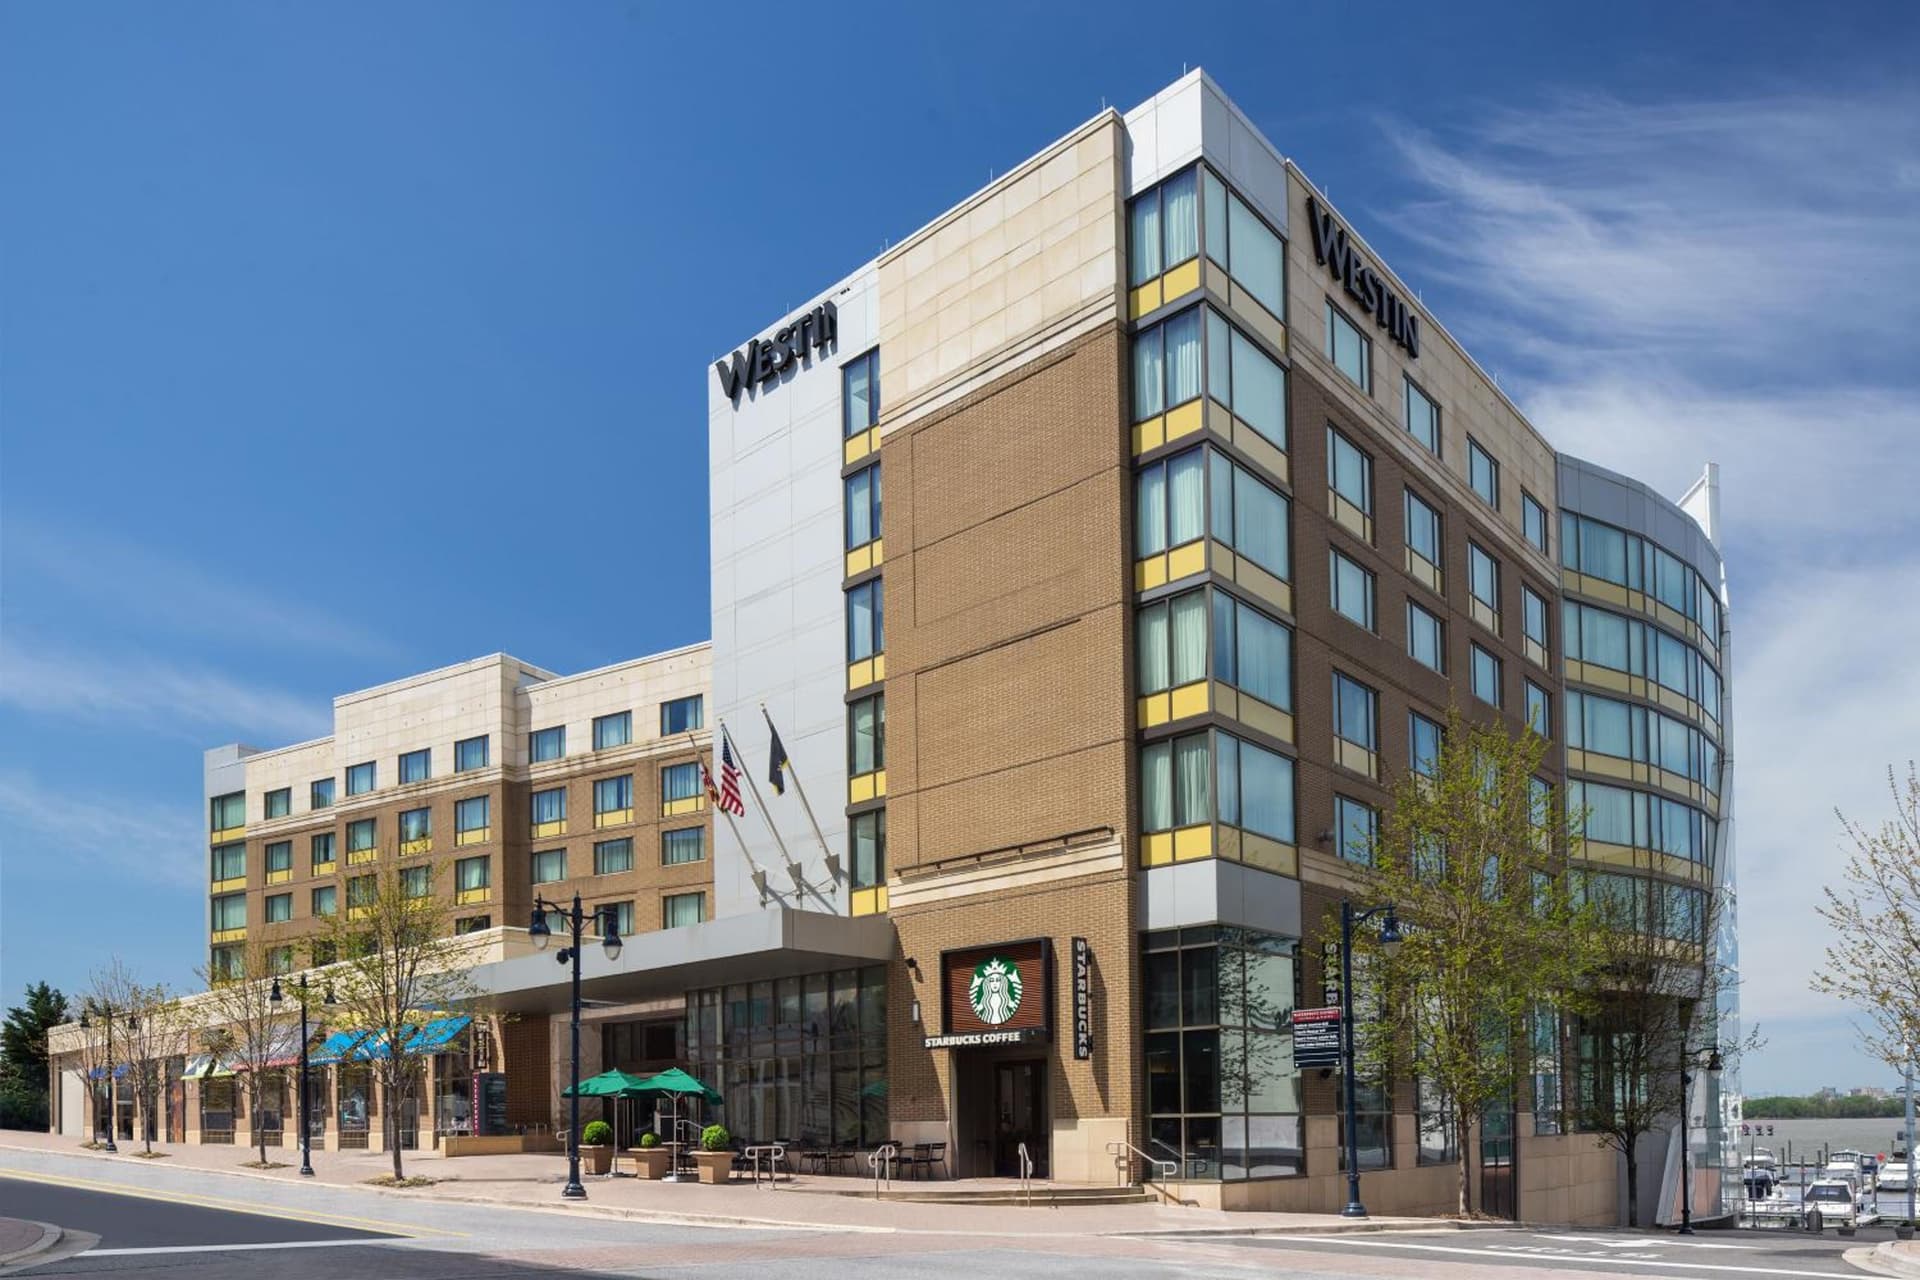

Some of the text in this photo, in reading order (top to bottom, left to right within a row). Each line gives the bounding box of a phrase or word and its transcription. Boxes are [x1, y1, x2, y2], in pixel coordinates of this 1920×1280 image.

[1306, 195, 1419, 359] WESTIN
[715, 300, 838, 399] WESTIN
[925, 1032, 1020, 1047] STARBUCKS COFFEE
[1076, 940, 1088, 1057] STARBUCKS
